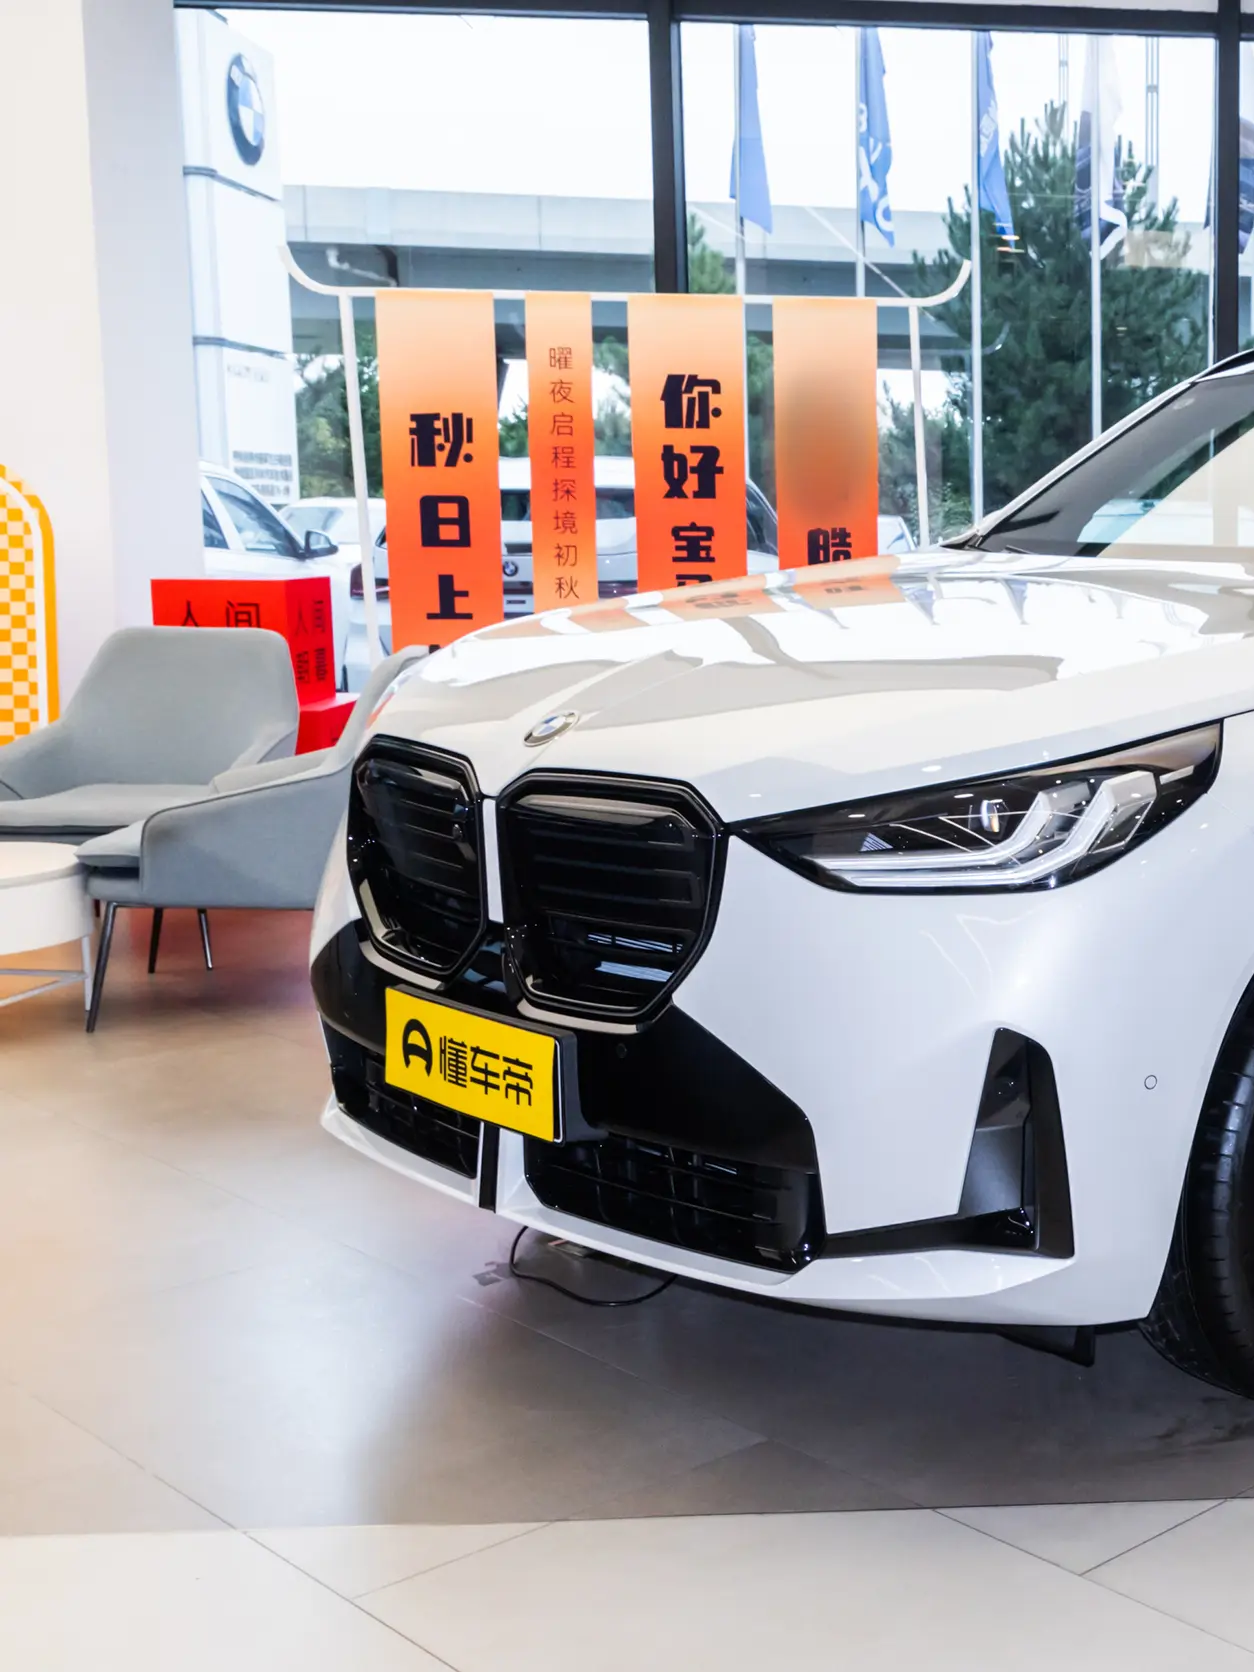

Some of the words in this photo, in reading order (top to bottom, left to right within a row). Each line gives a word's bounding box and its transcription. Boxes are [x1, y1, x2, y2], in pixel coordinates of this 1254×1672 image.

[409, 412, 474, 654] 秋日上
[549, 347, 579, 600] 曜夜启程探境初秋
[439, 1036, 534, 1107] 懂车帝
